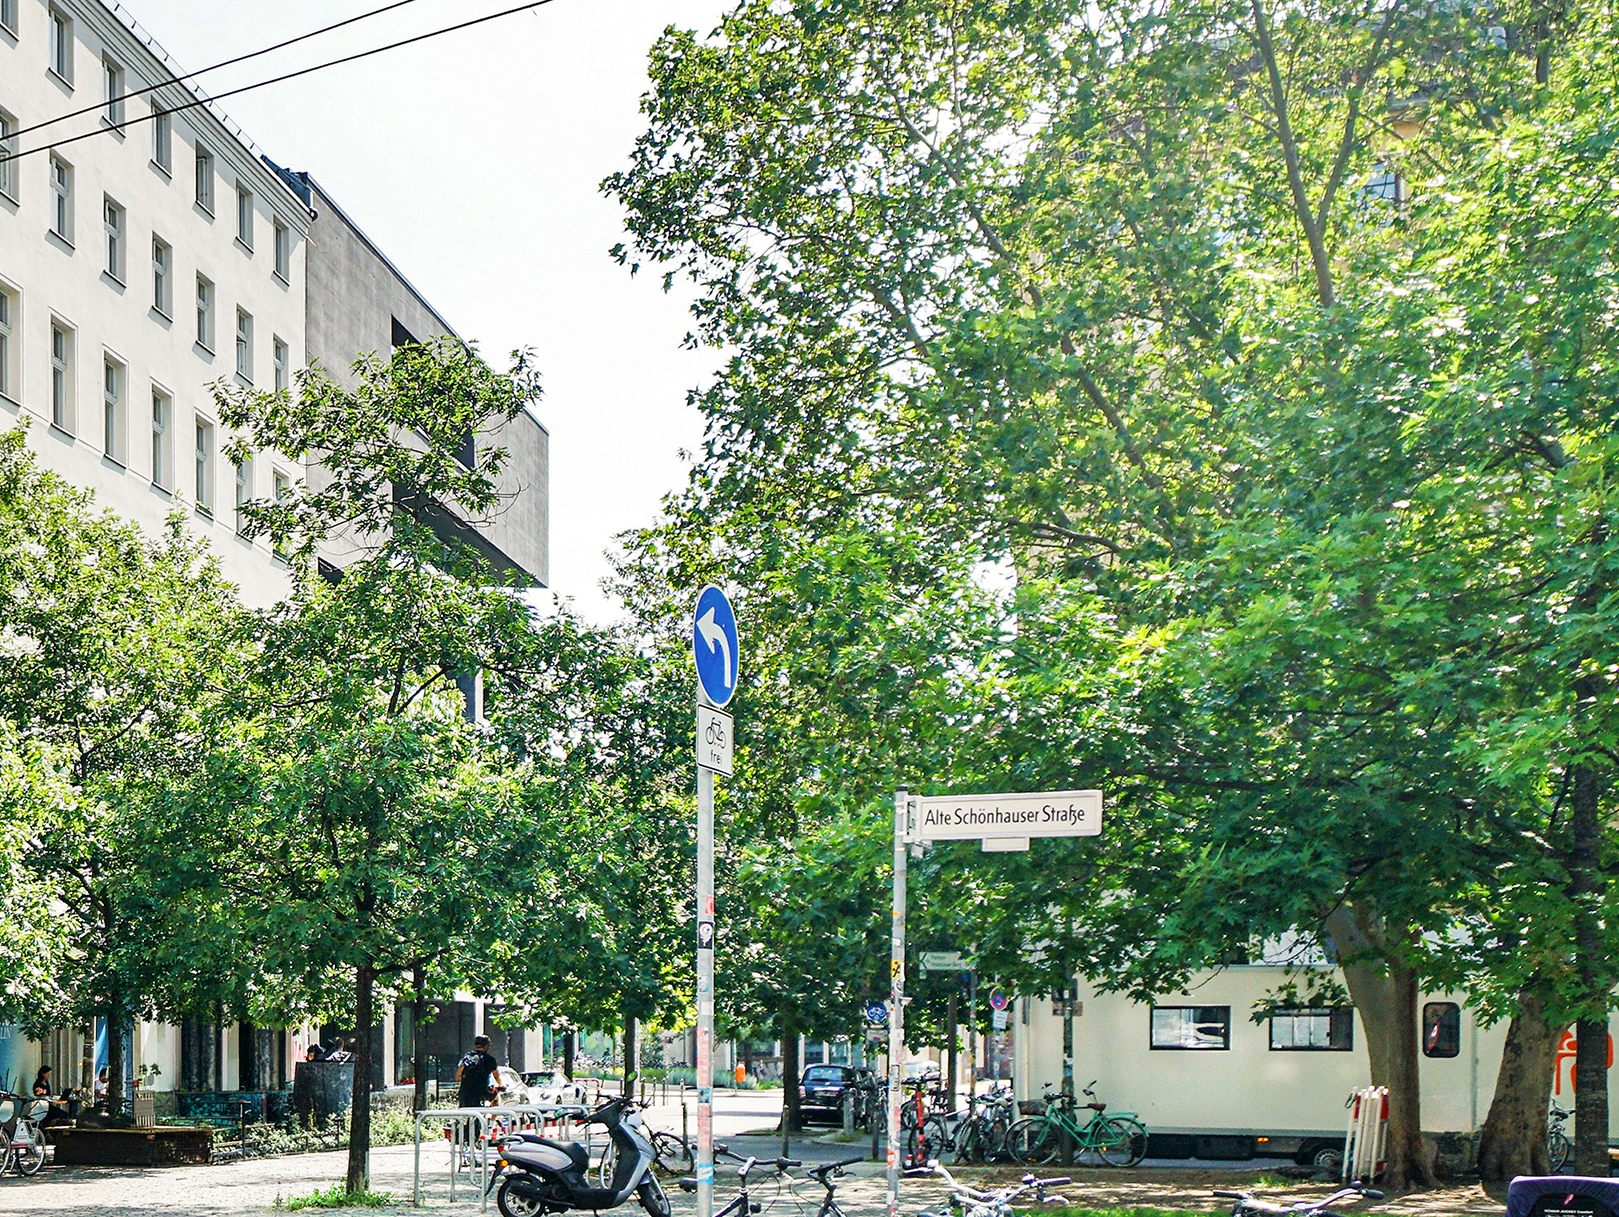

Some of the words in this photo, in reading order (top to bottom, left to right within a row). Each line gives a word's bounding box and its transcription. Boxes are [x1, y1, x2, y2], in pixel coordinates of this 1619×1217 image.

[712, 750, 723, 764] frei
[924, 808, 952, 826] Alte
[954, 806, 1040, 825] Schönhauser
[1042, 804, 1085, 826] Straße
